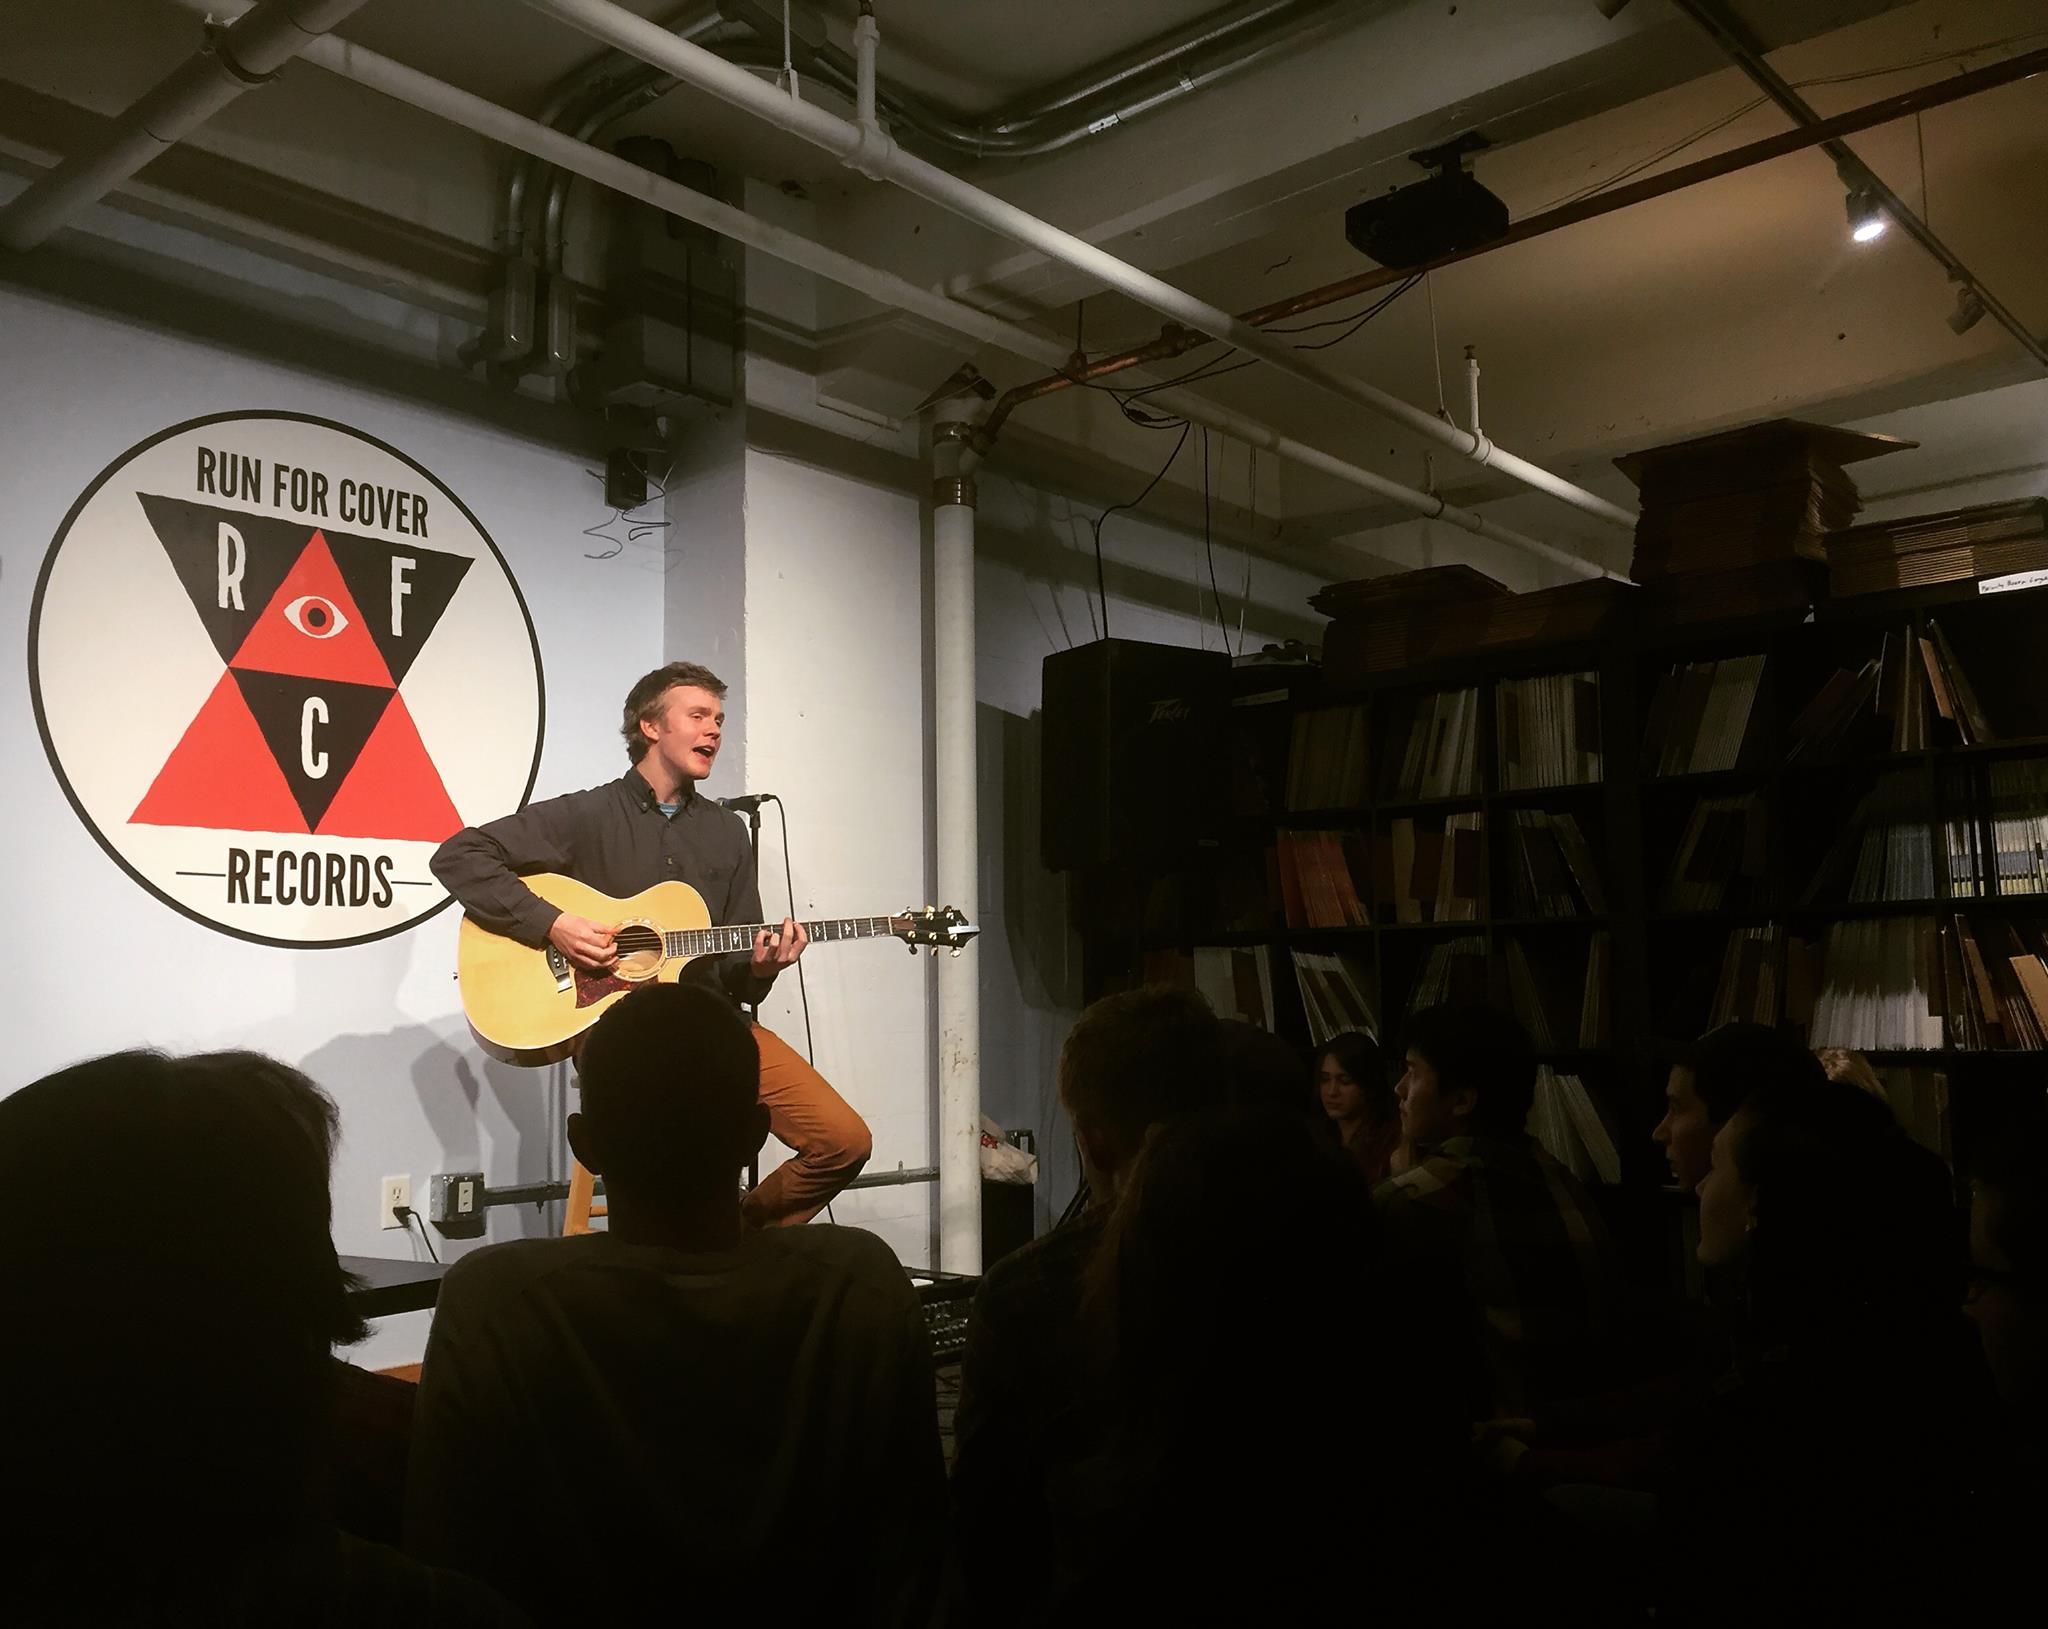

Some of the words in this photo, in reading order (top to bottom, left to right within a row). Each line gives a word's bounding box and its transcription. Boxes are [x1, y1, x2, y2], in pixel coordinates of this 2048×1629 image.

[197, 446, 261, 504] RUN
[273, 463, 328, 517] FOR
[339, 478, 428, 538] COVER
[218, 521, 246, 611] R
[391, 555, 416, 637] F
[301, 696, 329, 779] C
[227, 848, 393, 908] RECORDS
